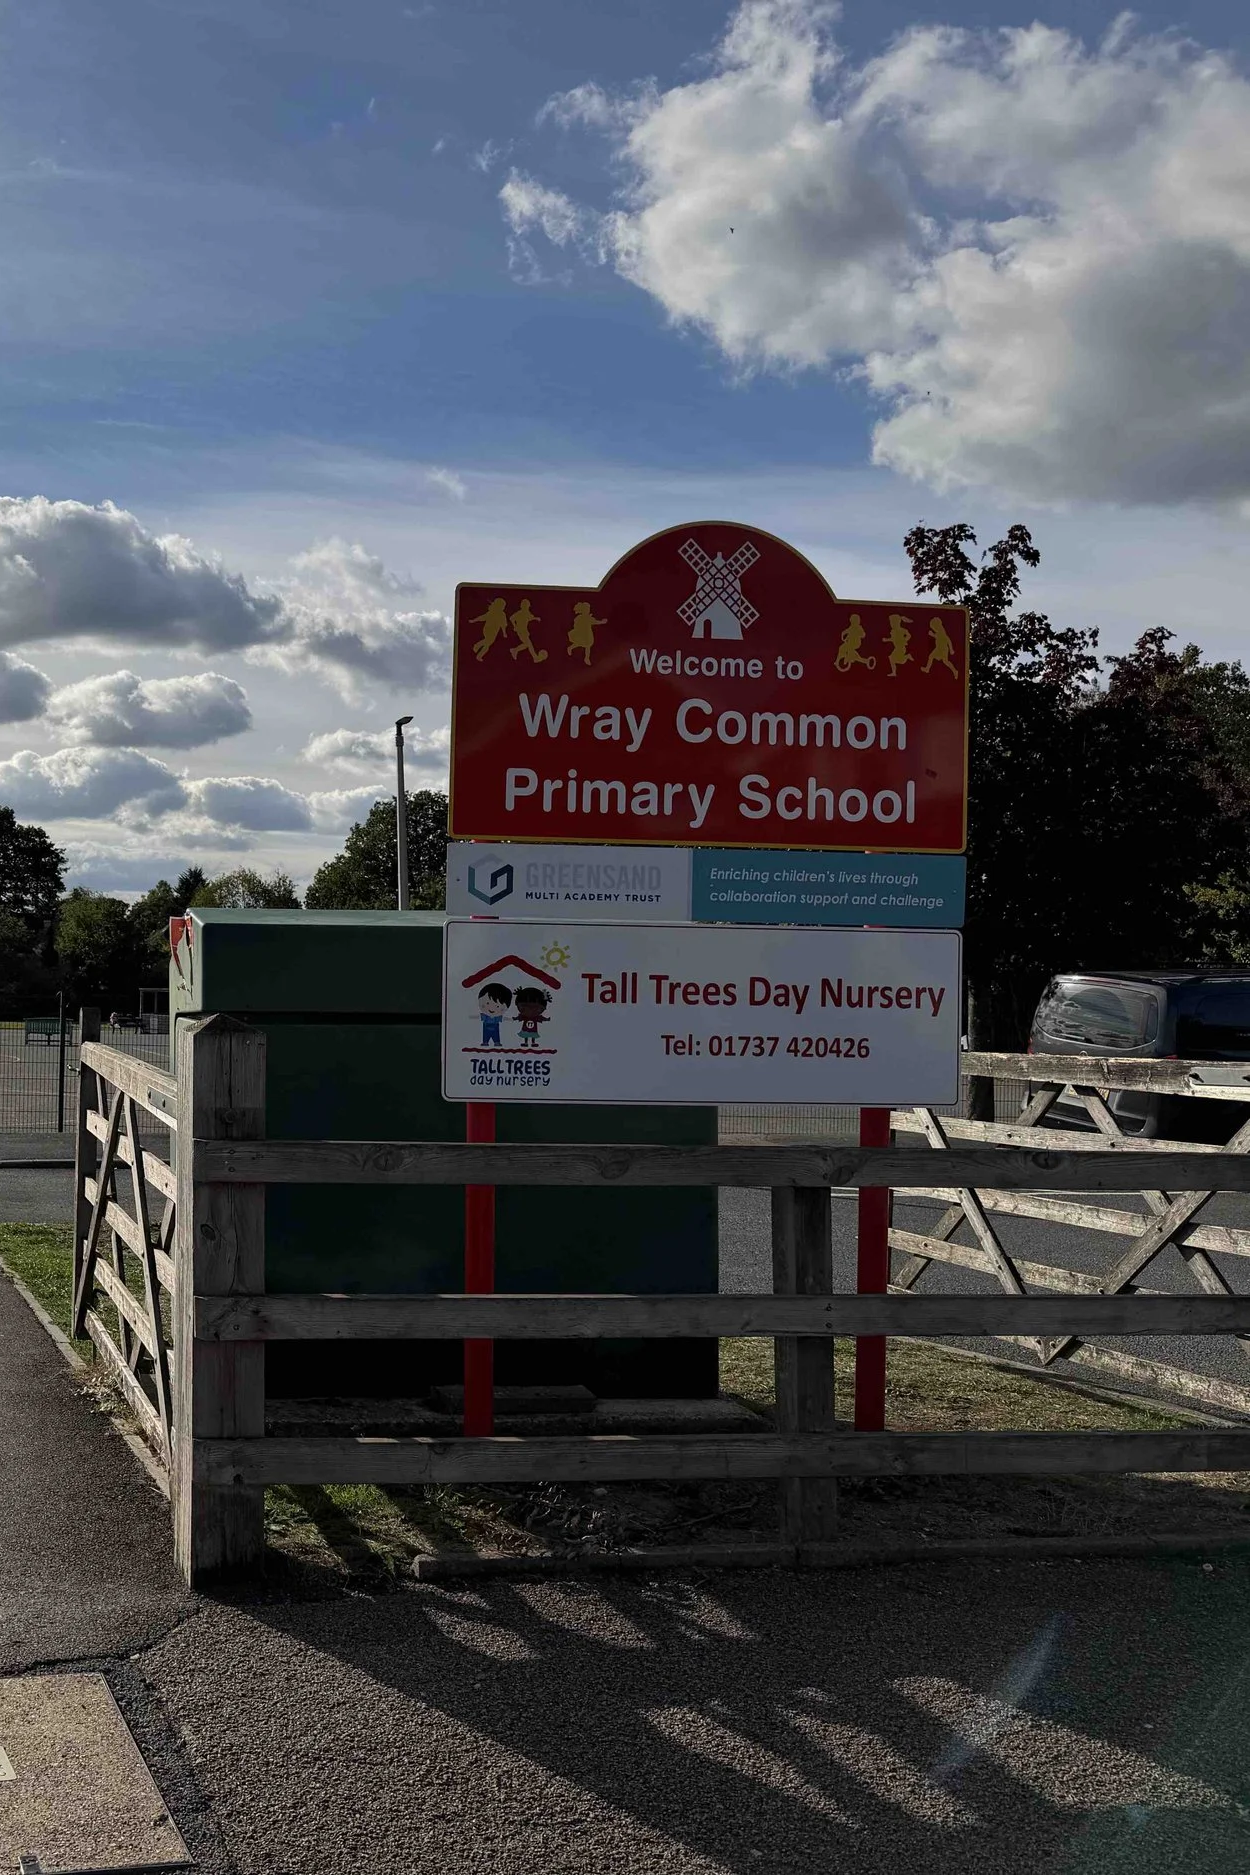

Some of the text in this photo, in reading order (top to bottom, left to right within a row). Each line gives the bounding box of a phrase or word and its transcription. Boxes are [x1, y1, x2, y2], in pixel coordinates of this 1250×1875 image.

[630, 648, 804, 681] Welcome to
[518, 692, 907, 753] Wray Common
[505, 767, 916, 829] Primary School
[525, 862, 662, 891] GREENSAND
[710, 868, 919, 887] Enriching children's lives through
[525, 891, 662, 902] MULTI ACADEMY TRUST
[709, 890, 944, 910] collaboration support and challenge
[581, 972, 946, 1018] Tall Trees Day Nursery
[660, 1034, 871, 1060] Tel: 01737 420426
[470, 1075, 551, 1087] day nursery
